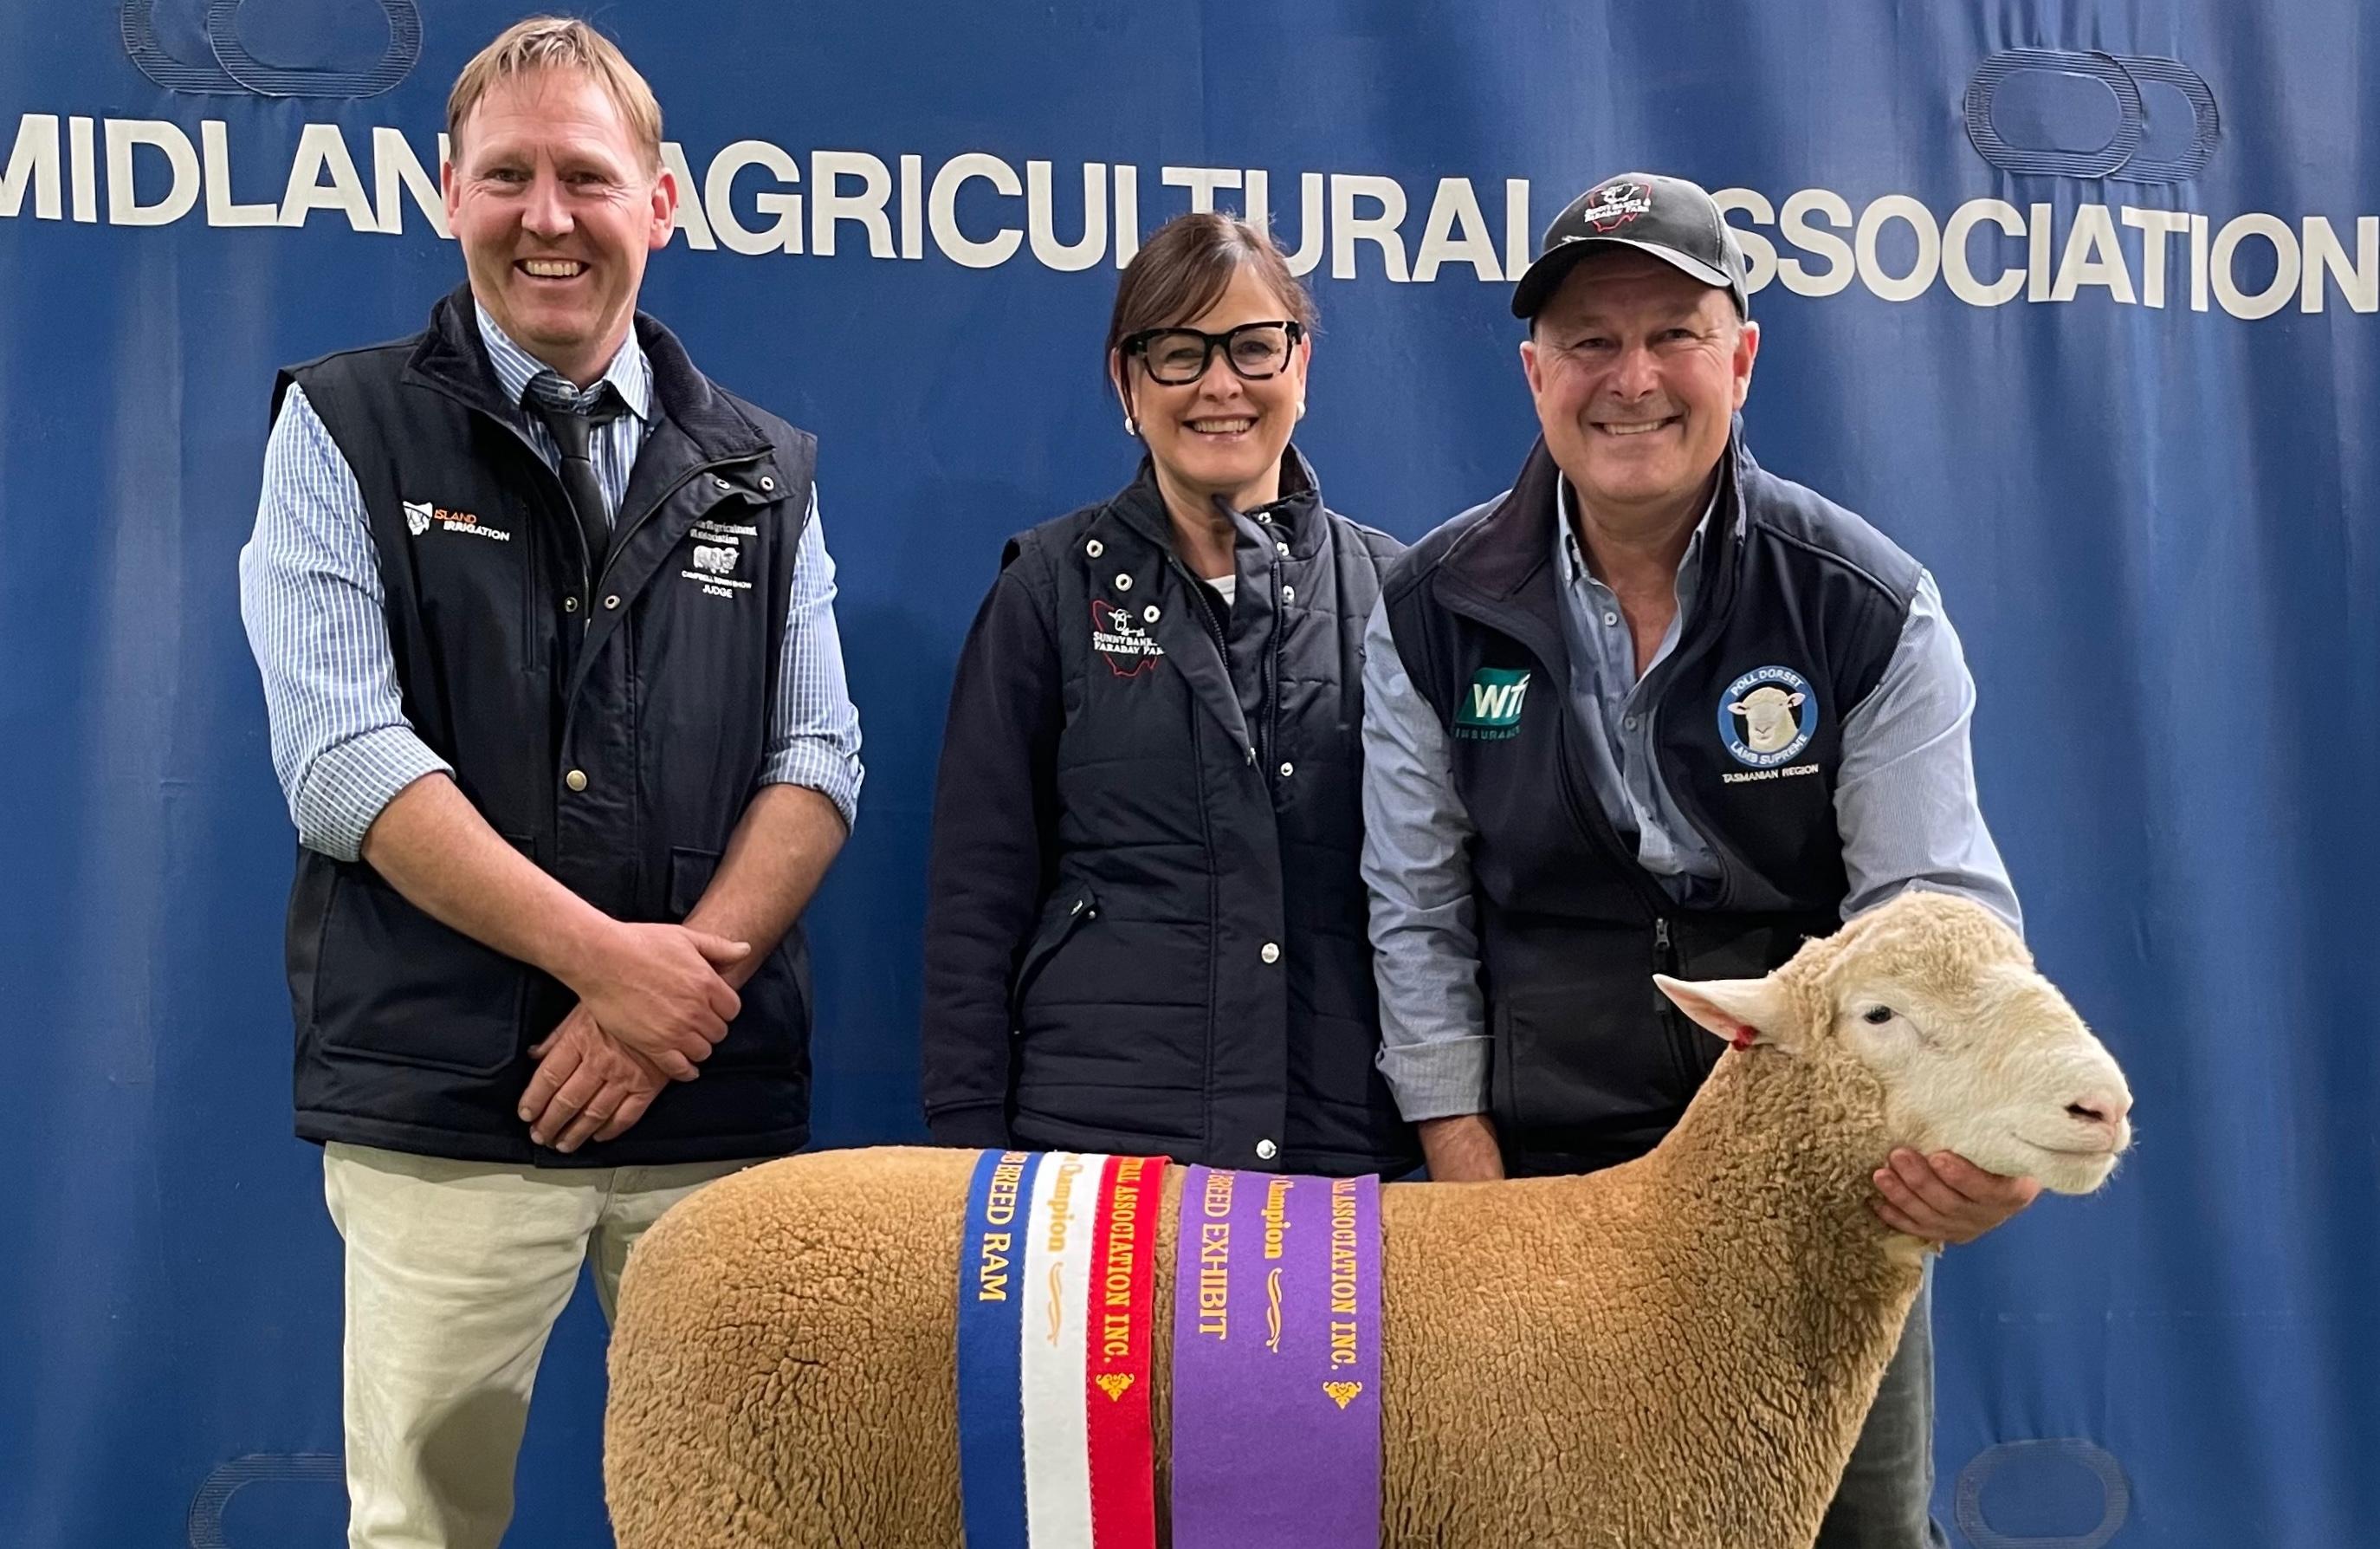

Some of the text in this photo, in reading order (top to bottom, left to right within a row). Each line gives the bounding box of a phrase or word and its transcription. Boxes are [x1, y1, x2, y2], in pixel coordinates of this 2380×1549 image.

[0, 113, 2379, 321] MIDLAN AGRICULTURAL SSOCIATION
[434, 509, 477, 524] ISLAND
[443, 520, 510, 541] IRRIGATION
[702, 584, 733, 599] JUDGE
[1143, 645, 1165, 656] PAR
[1730, 669, 1805, 696] POLL DORSET
[1730, 734, 1808, 764] LAMB SUPREME
[1722, 764, 1819, 783] TASMANIAN REGION
[1105, 1184, 1140, 1306] ASSOCIATION
[1331, 1196, 1357, 1314] ASSOCIATION
[979, 1232, 1012, 1301] RAM
[1199, 1222, 1230, 1340] EXHIBIT
[1103, 1313, 1130, 1364] INC.
[1330, 1321, 1356, 1370] INC.
